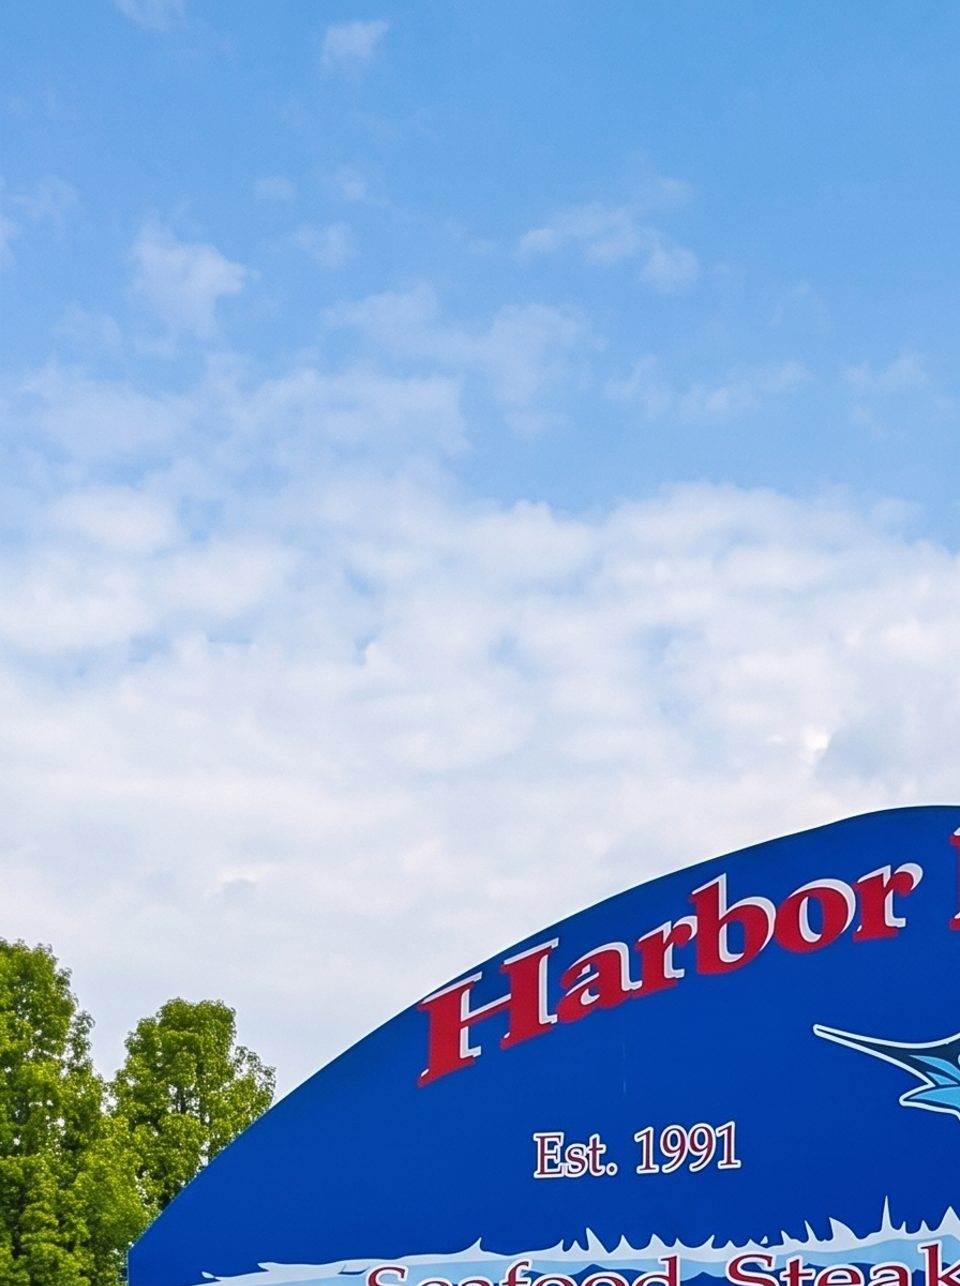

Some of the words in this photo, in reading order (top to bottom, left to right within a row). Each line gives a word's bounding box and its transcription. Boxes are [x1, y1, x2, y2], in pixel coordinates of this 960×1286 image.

[417, 863, 924, 1088] Harbor
[534, 1132, 618, 1179] Est.
[634, 1121, 741, 1173] 1991
